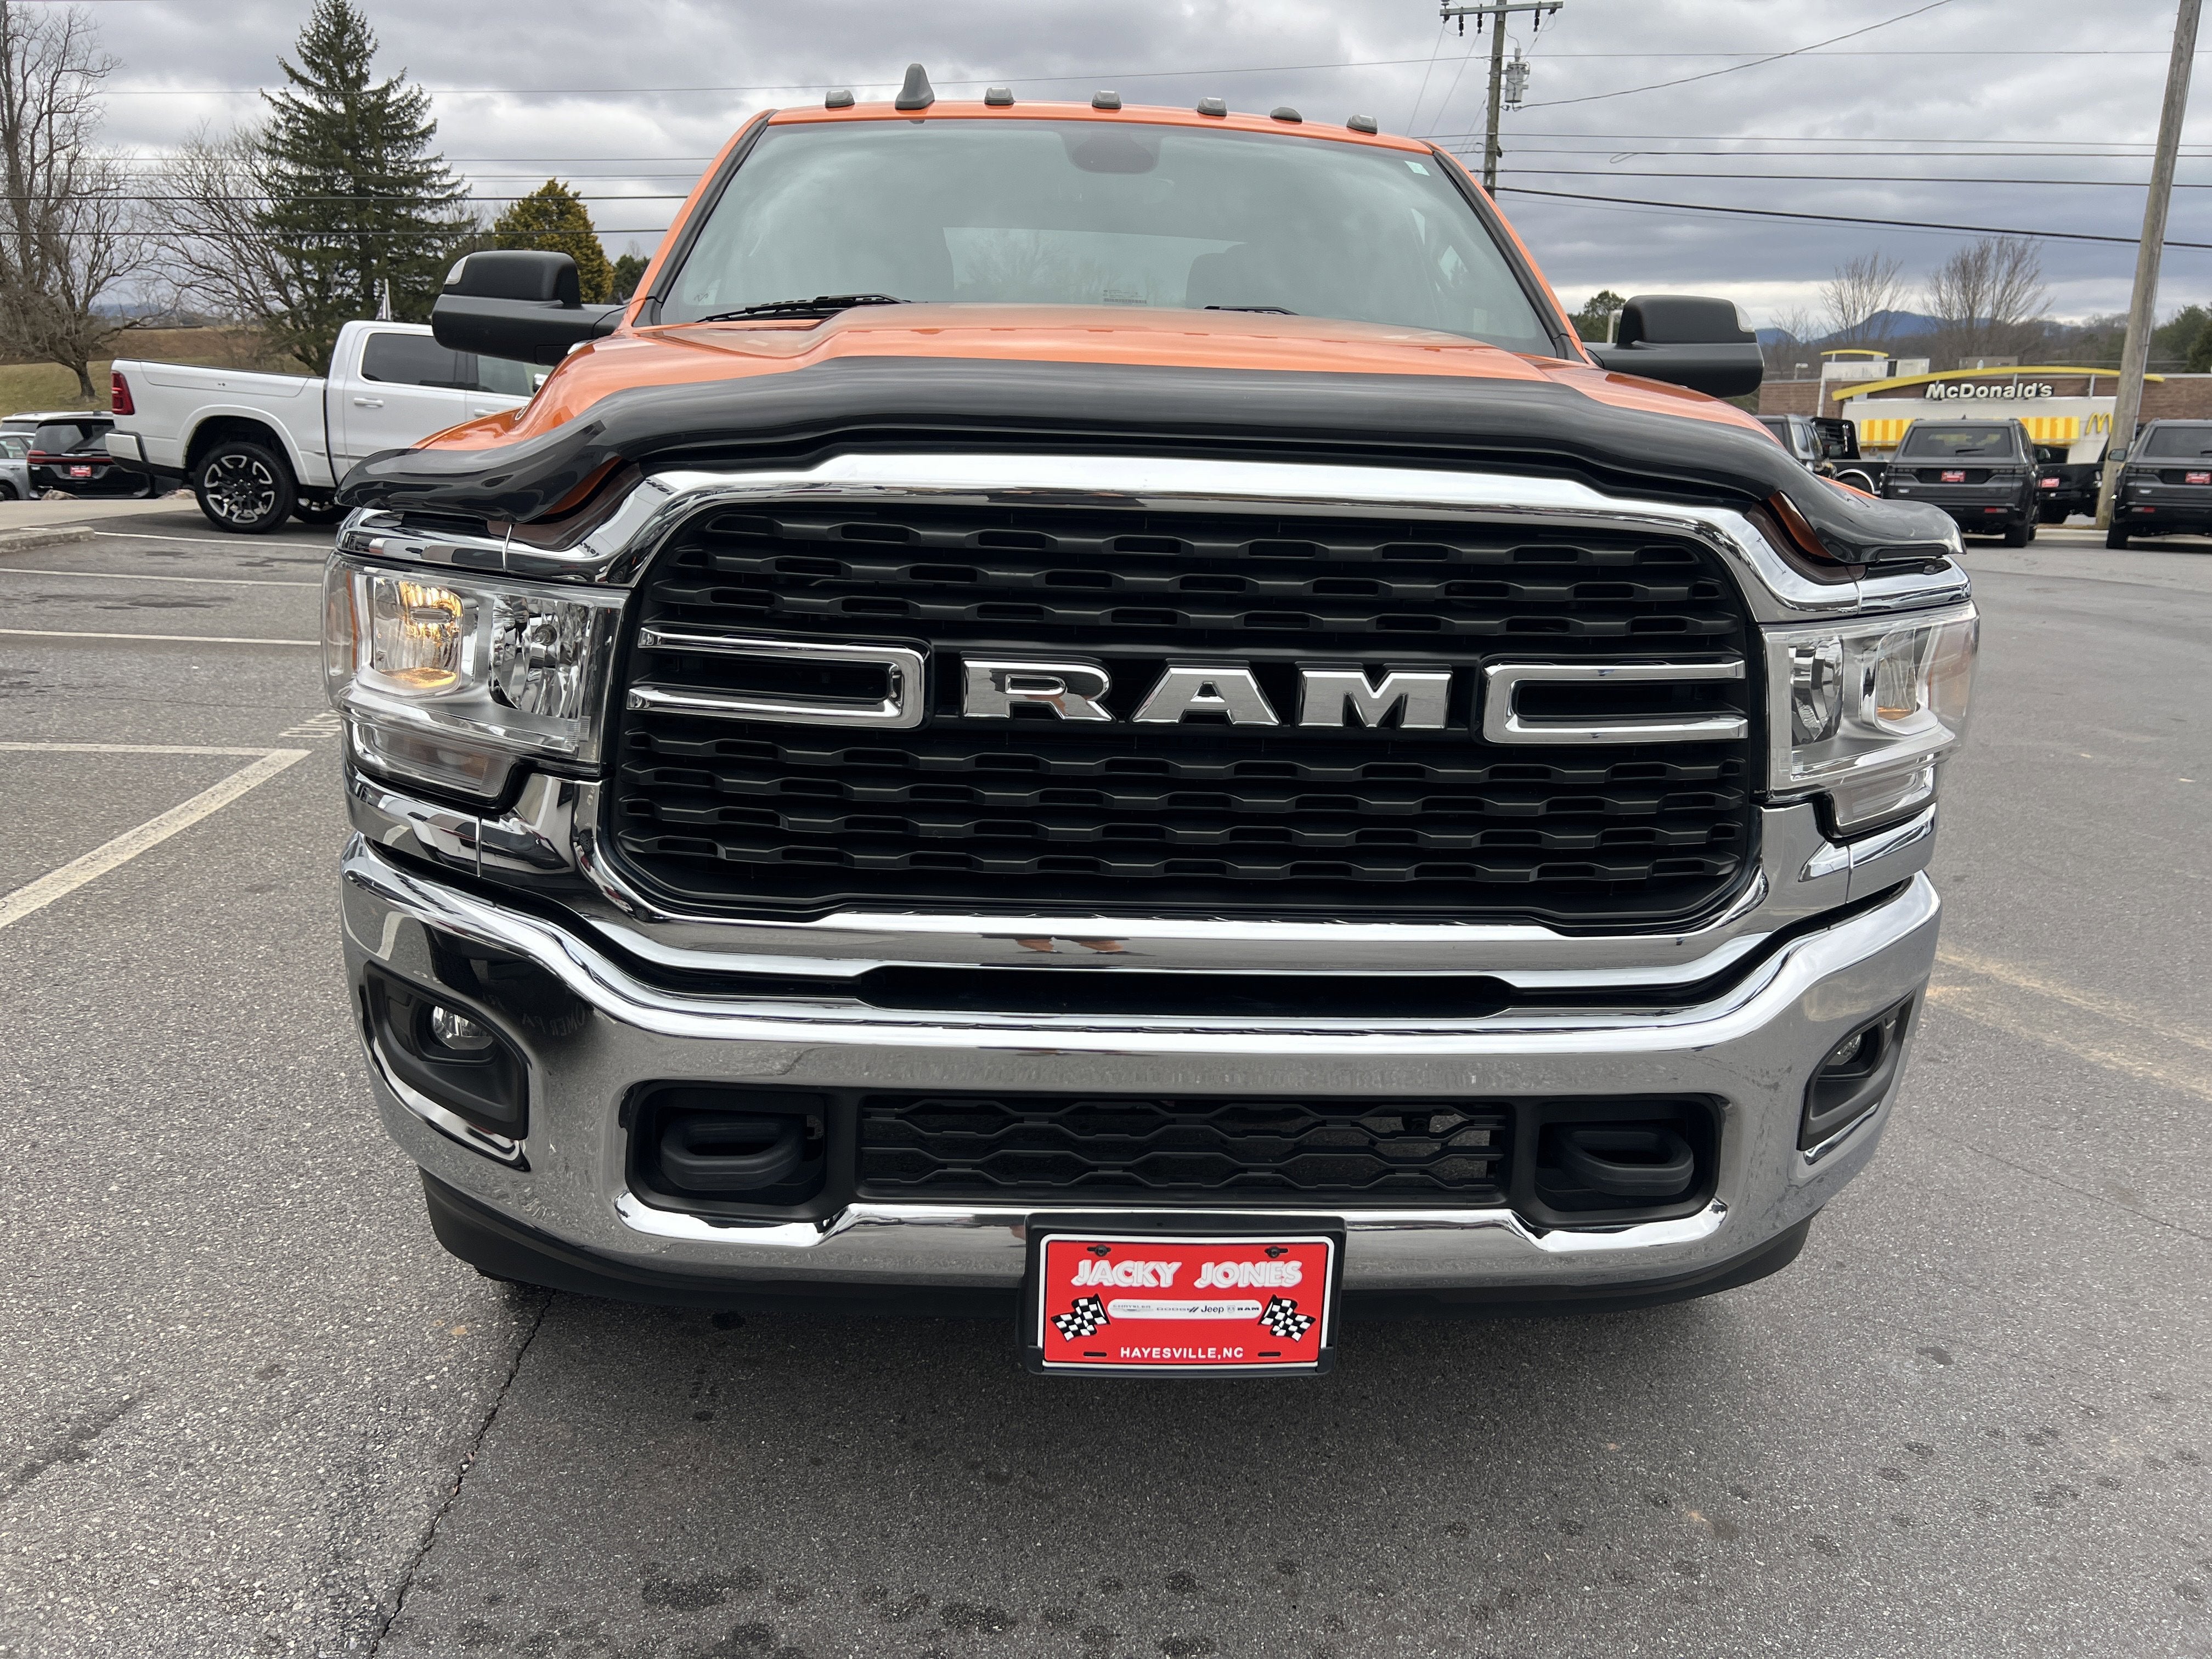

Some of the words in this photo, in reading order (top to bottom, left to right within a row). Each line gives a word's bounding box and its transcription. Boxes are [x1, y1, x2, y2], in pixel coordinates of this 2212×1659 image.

[1925, 382, 2053, 399] McDonald's
[962, 656, 1453, 730] RAM
[1070, 1259, 1182, 1288] JACKY
[1193, 1261, 1302, 1289] JONES
[1200, 1305, 1224, 1314] Jeep
[1120, 1346, 1244, 1360] HAYESVILLE,NC
